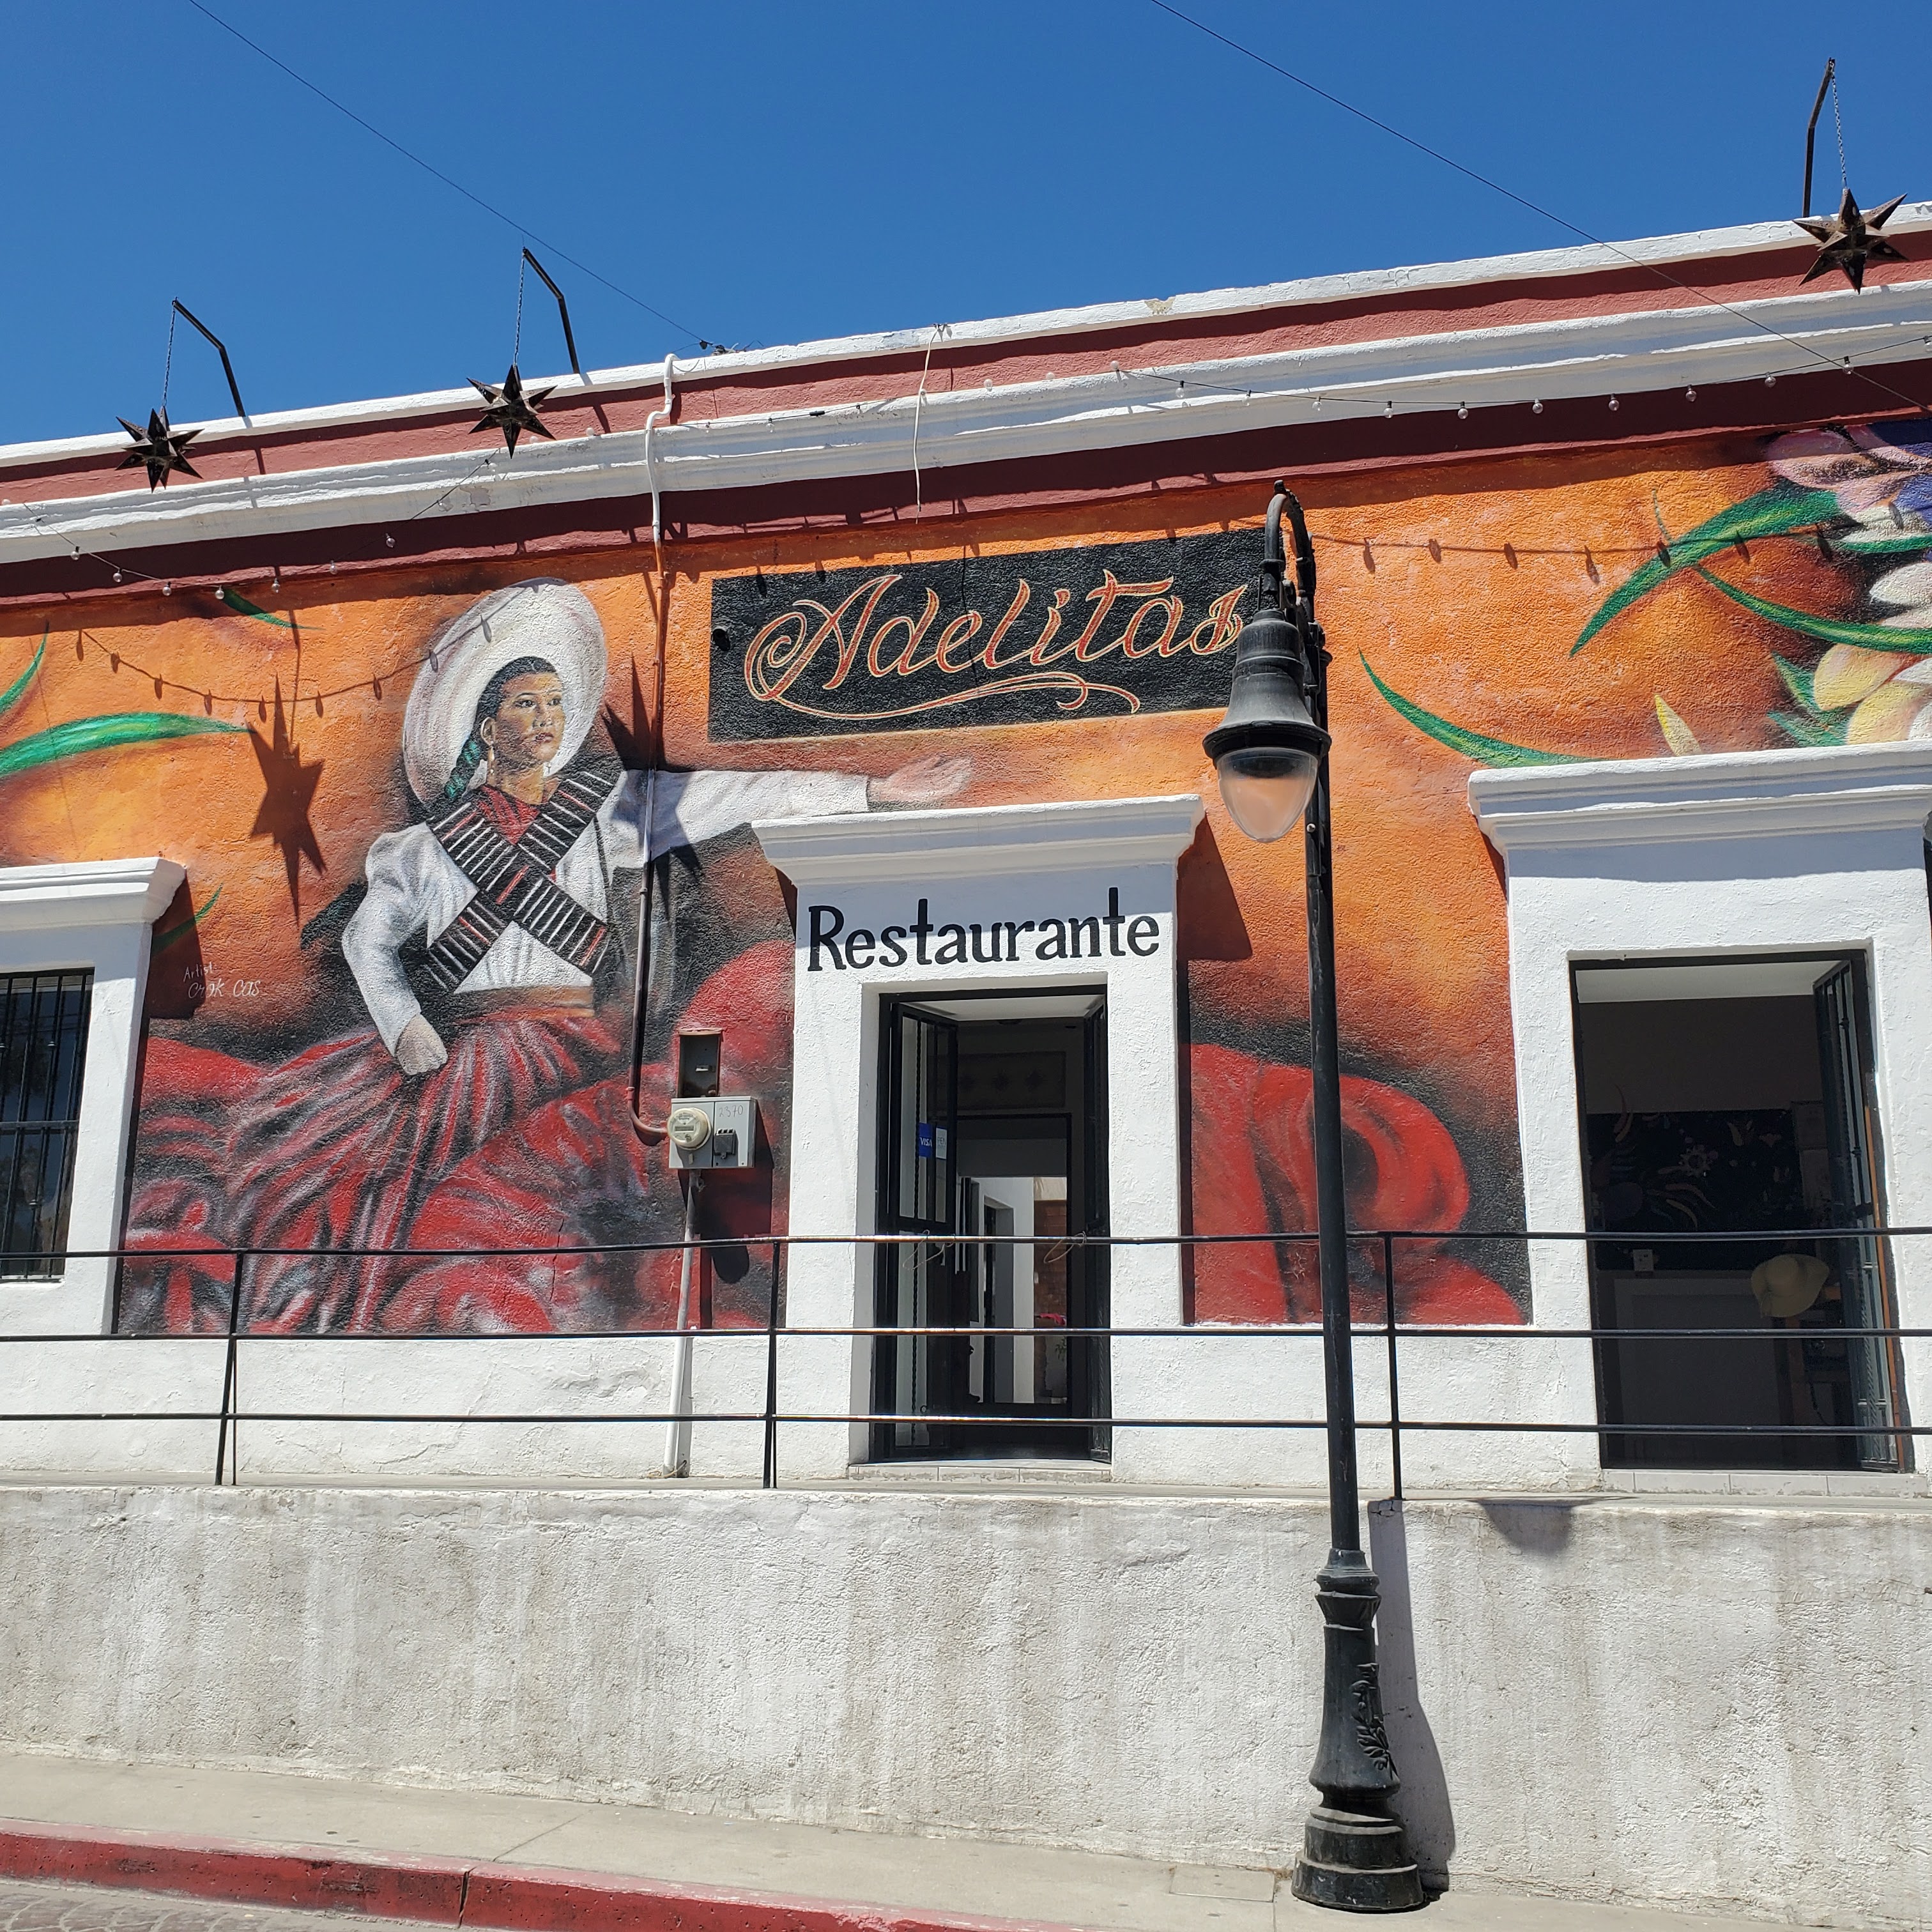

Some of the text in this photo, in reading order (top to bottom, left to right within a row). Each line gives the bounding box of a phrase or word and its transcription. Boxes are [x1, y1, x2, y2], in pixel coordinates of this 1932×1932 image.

[744, 569, 1248, 701] Adelitas
[808, 887, 1160, 971] Restaurante
[719, 1105, 744, 1117] 2370
[920, 1137, 932, 1147] VISA
